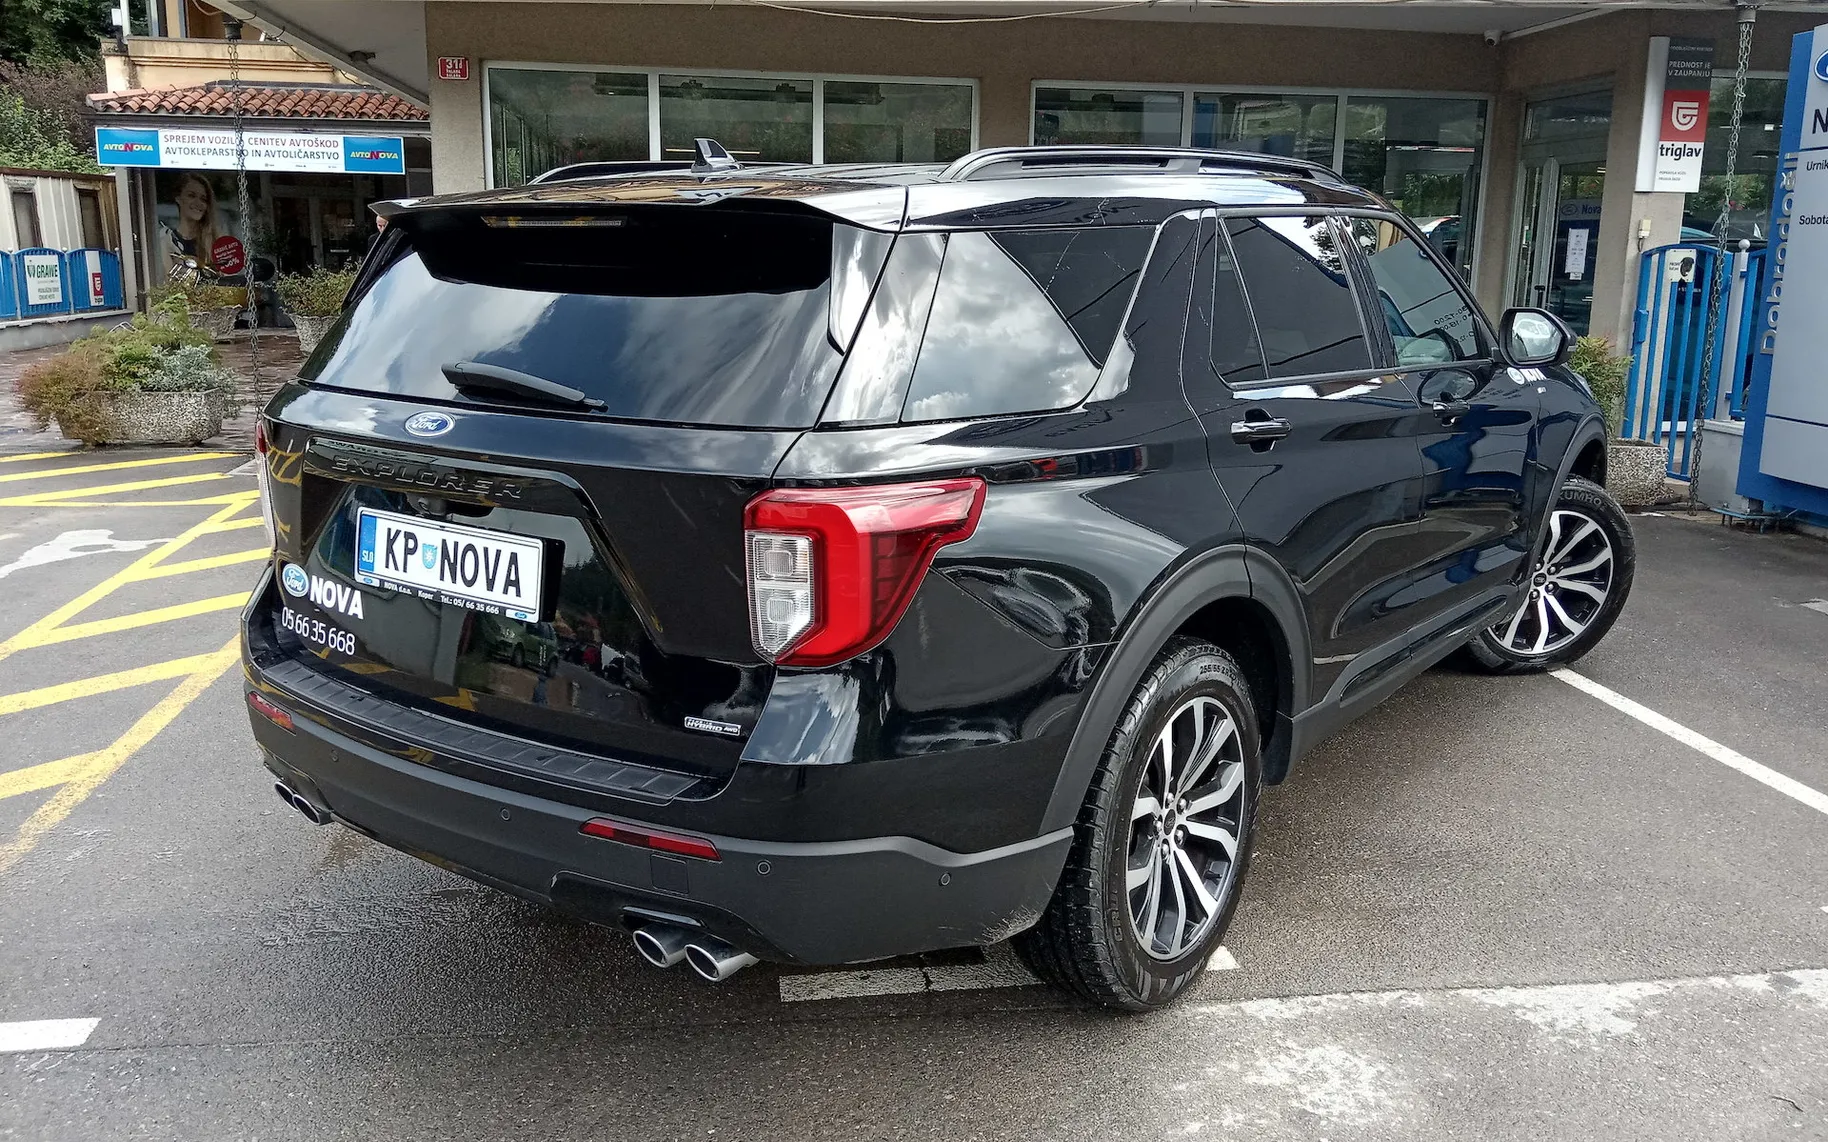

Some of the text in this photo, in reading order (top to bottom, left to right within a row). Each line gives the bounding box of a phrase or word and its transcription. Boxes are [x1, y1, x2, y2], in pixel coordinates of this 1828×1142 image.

[1668, 60, 1703, 68] PREDNOST
[1674, 69, 1710, 77] ZAUPANJU
[164, 134, 206, 144] SPREJEM
[248, 137, 286, 147] CENITEV
[289, 137, 339, 148] AVTOŠKOD
[252, 149, 261, 158] IN
[264, 149, 339, 160] AVTOLIČARSTVO
[1660, 143, 1702, 161] triglav
[1760, 152, 1799, 355] Dobrodošli
[36, 265, 58, 278] GRAWE
[410, 415, 442, 431] Ford
[332, 455, 523, 498] EXPLORER
[361, 550, 374, 564] SLO
[385, 527, 521, 597] KP NOVA
[286, 568, 364, 620] Ford NOVA
[384, 581, 398, 592] NOVA
[418, 590, 434, 600] Koper
[453, 598, 464, 608] 05/
[466, 601, 475, 609] 66
[476, 603, 485, 612] 35
[486, 605, 499, 615] 666
[282, 606, 355, 655] 05 66 35 668
[687, 721, 723, 731] HYBRID
